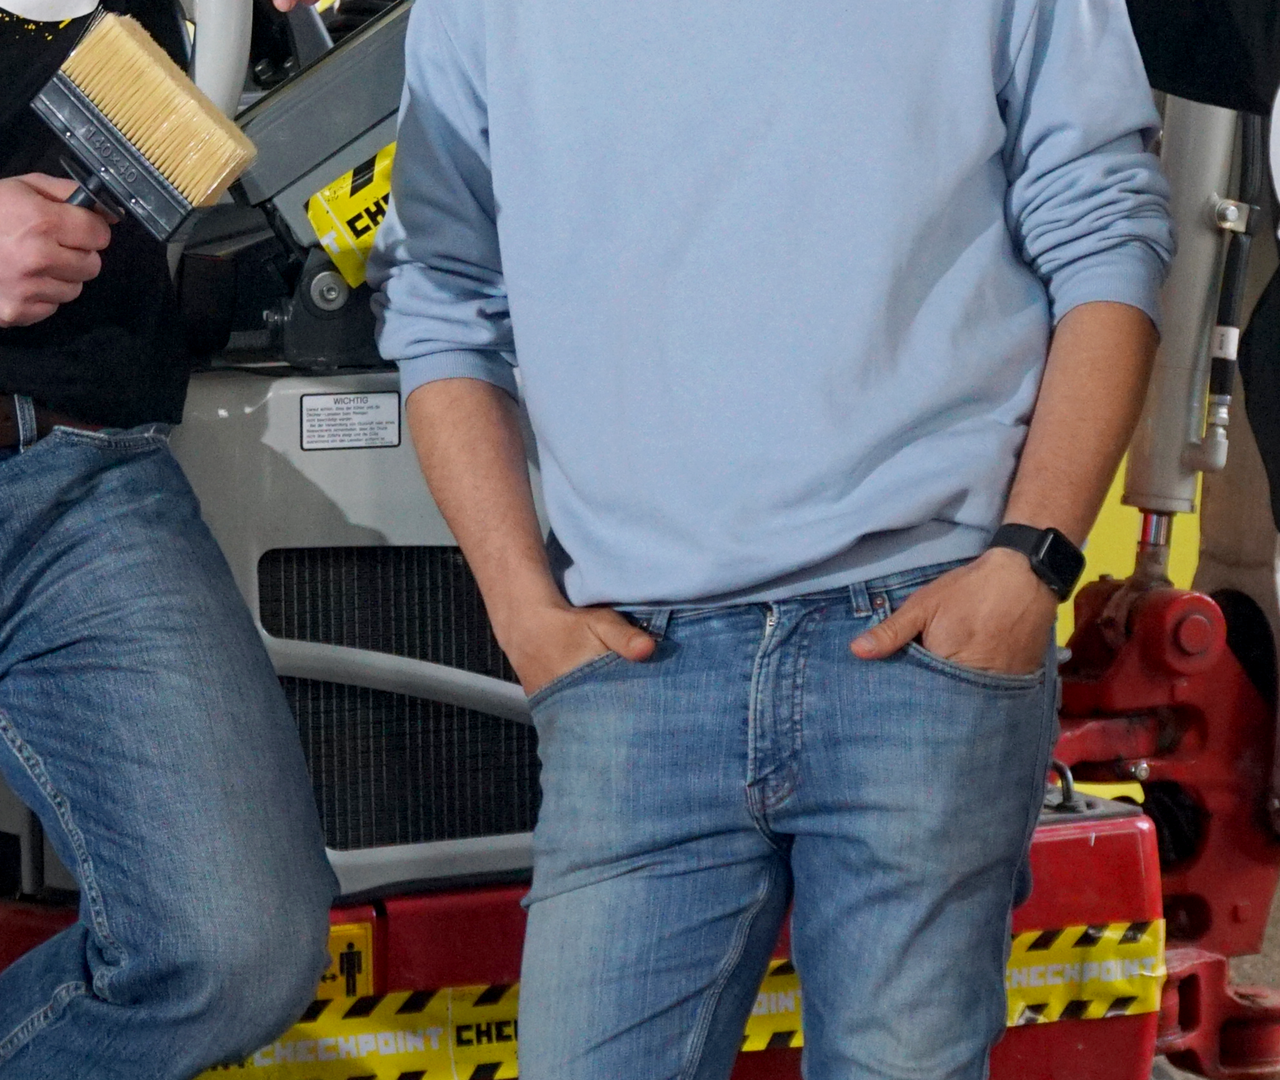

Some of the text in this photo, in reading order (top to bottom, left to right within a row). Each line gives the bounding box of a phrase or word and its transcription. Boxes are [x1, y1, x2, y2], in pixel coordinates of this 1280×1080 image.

[333, 396, 369, 405] WICHTIG
[1006, 957, 1156, 990] HECKPOINT
[252, 1025, 444, 1068] CHECKPOINT
